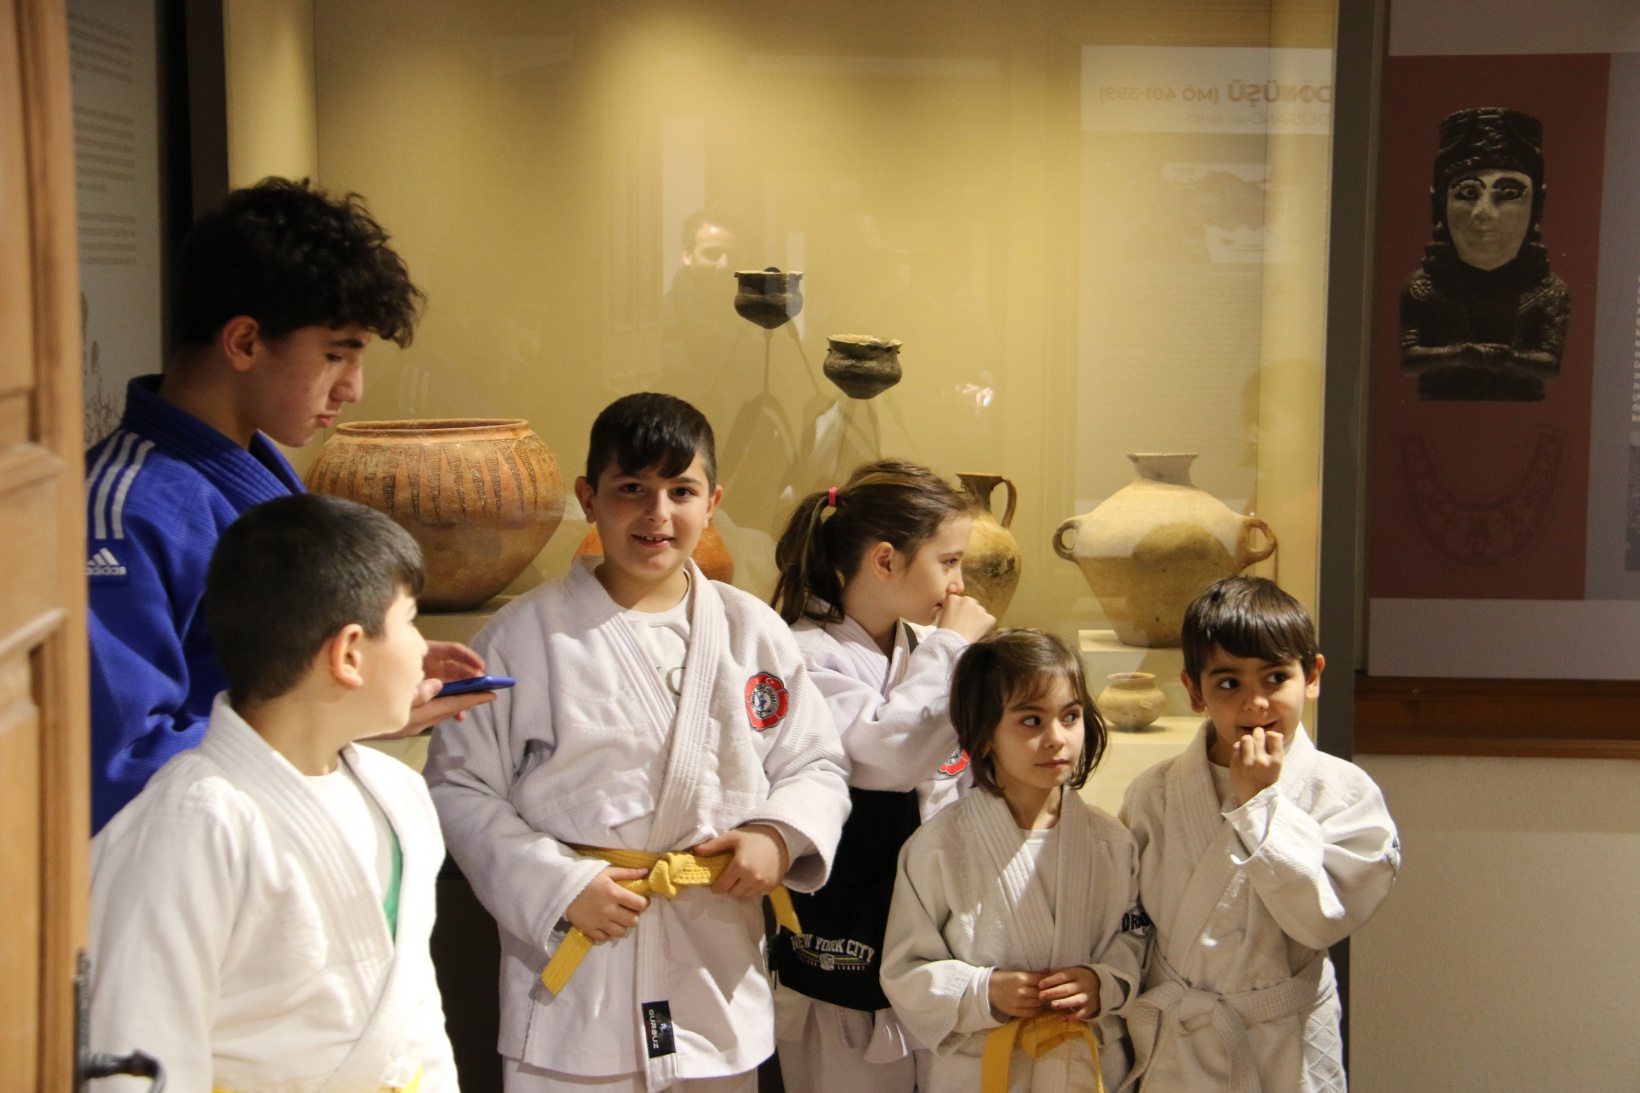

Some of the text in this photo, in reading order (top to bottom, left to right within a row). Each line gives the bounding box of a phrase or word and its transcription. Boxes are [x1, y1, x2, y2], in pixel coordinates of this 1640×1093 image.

[790, 934, 875, 963] NEW YORK CITY
